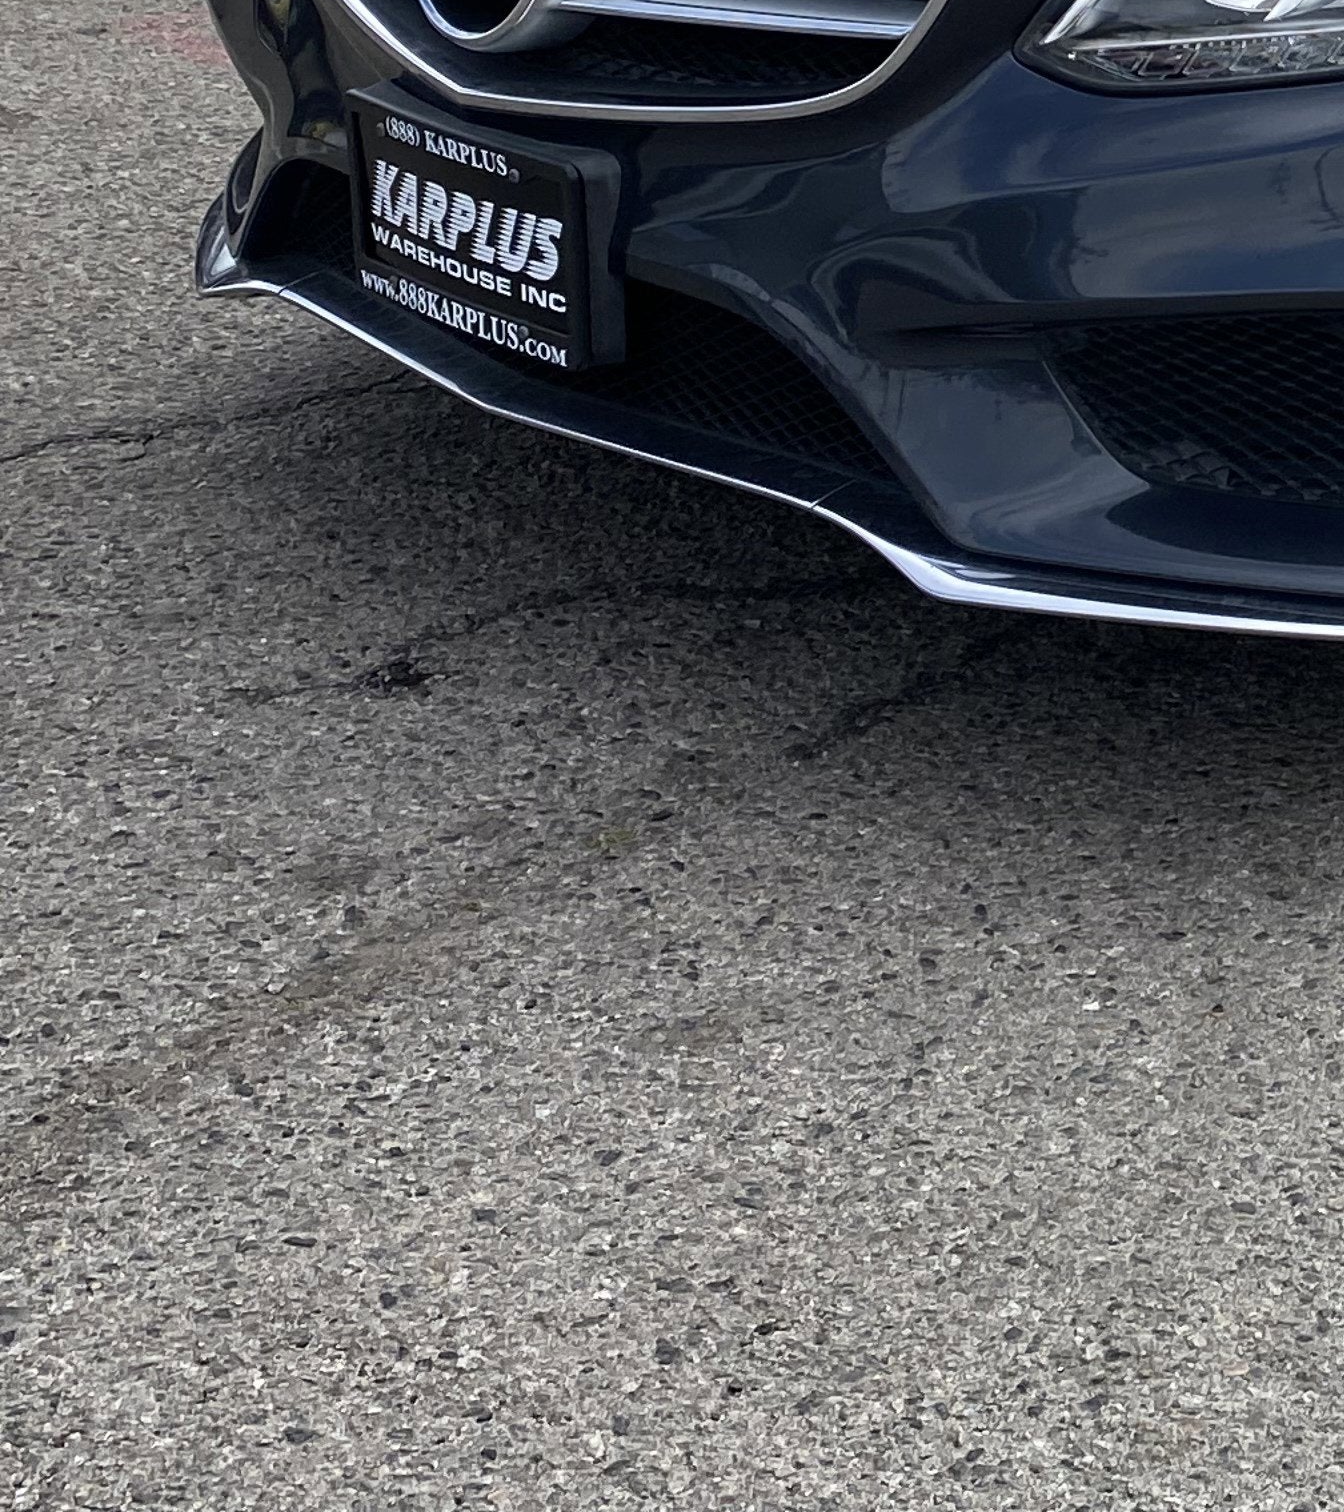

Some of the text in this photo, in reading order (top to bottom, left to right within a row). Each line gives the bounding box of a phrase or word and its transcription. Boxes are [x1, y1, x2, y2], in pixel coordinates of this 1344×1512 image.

[385, 116, 508, 177] (888) KARPLUS
[371, 159, 563, 281] KARPLUS
[371, 221, 567, 314] WAREHOUSE INC
